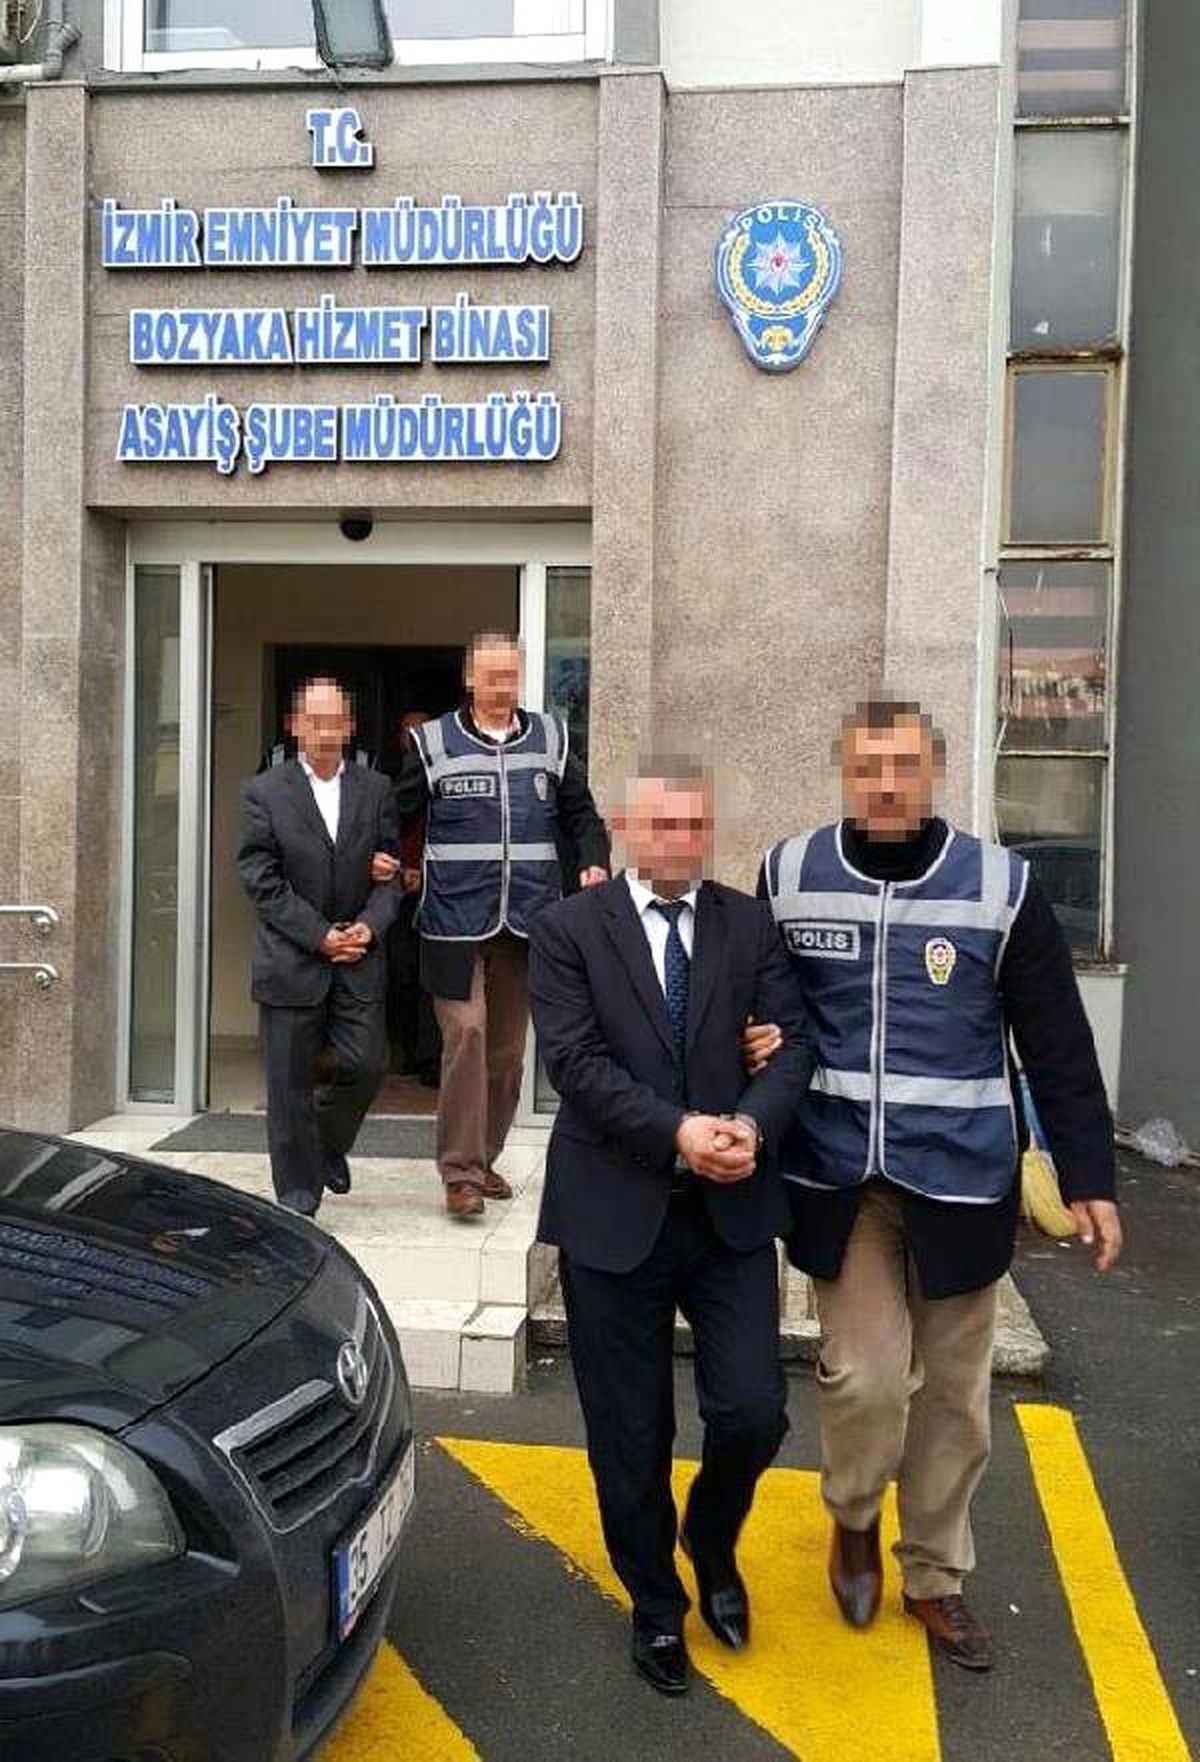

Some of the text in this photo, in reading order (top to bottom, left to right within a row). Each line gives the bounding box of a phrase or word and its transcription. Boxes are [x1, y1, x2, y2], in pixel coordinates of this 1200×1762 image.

[307, 109, 373, 167] T.C.
[103, 193, 584, 266] İZMİR EMNİYET MÜDÜRLÜĞÜ
[130, 292, 549, 363] BOZYAKA HİZMET BİNASI
[117, 393, 561, 475] ASAYİŞ ŞUBE MÜDÜRLÜĞÜ
